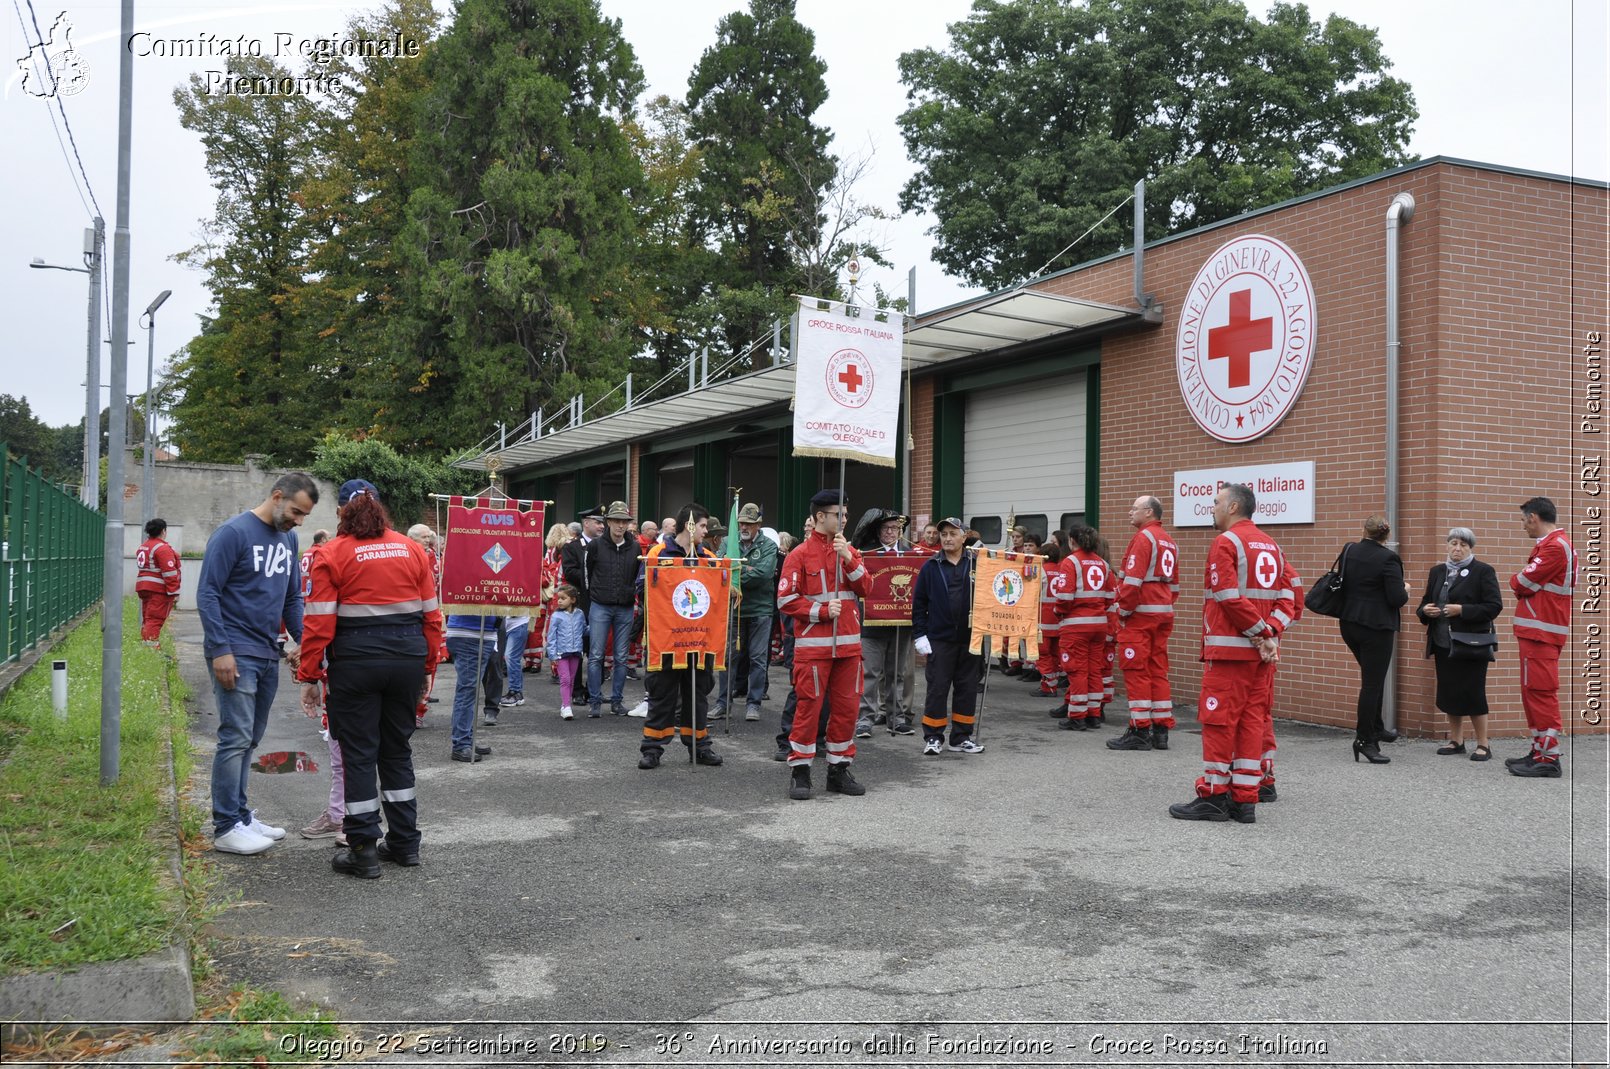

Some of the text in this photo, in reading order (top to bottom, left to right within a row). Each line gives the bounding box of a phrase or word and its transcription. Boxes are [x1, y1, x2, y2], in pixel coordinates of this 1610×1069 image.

[808, 319, 894, 341] CROCE ROSSA ITALIANA
[1182, 246, 1306, 429] CONVENZIONE DI GINEVRA 22 AGOSTO 1864
[806, 421, 886, 439] COMITATO LOCALE DI
[1179, 482, 1213, 497] Croce
[1258, 476, 1305, 493] Italiana
[356, 549, 410, 562] CARABINIERI
[464, 585, 524, 595] OLEGGIO
[991, 611, 1015, 620] SQUADRA
[987, 623, 1026, 633] OLEGGIO
